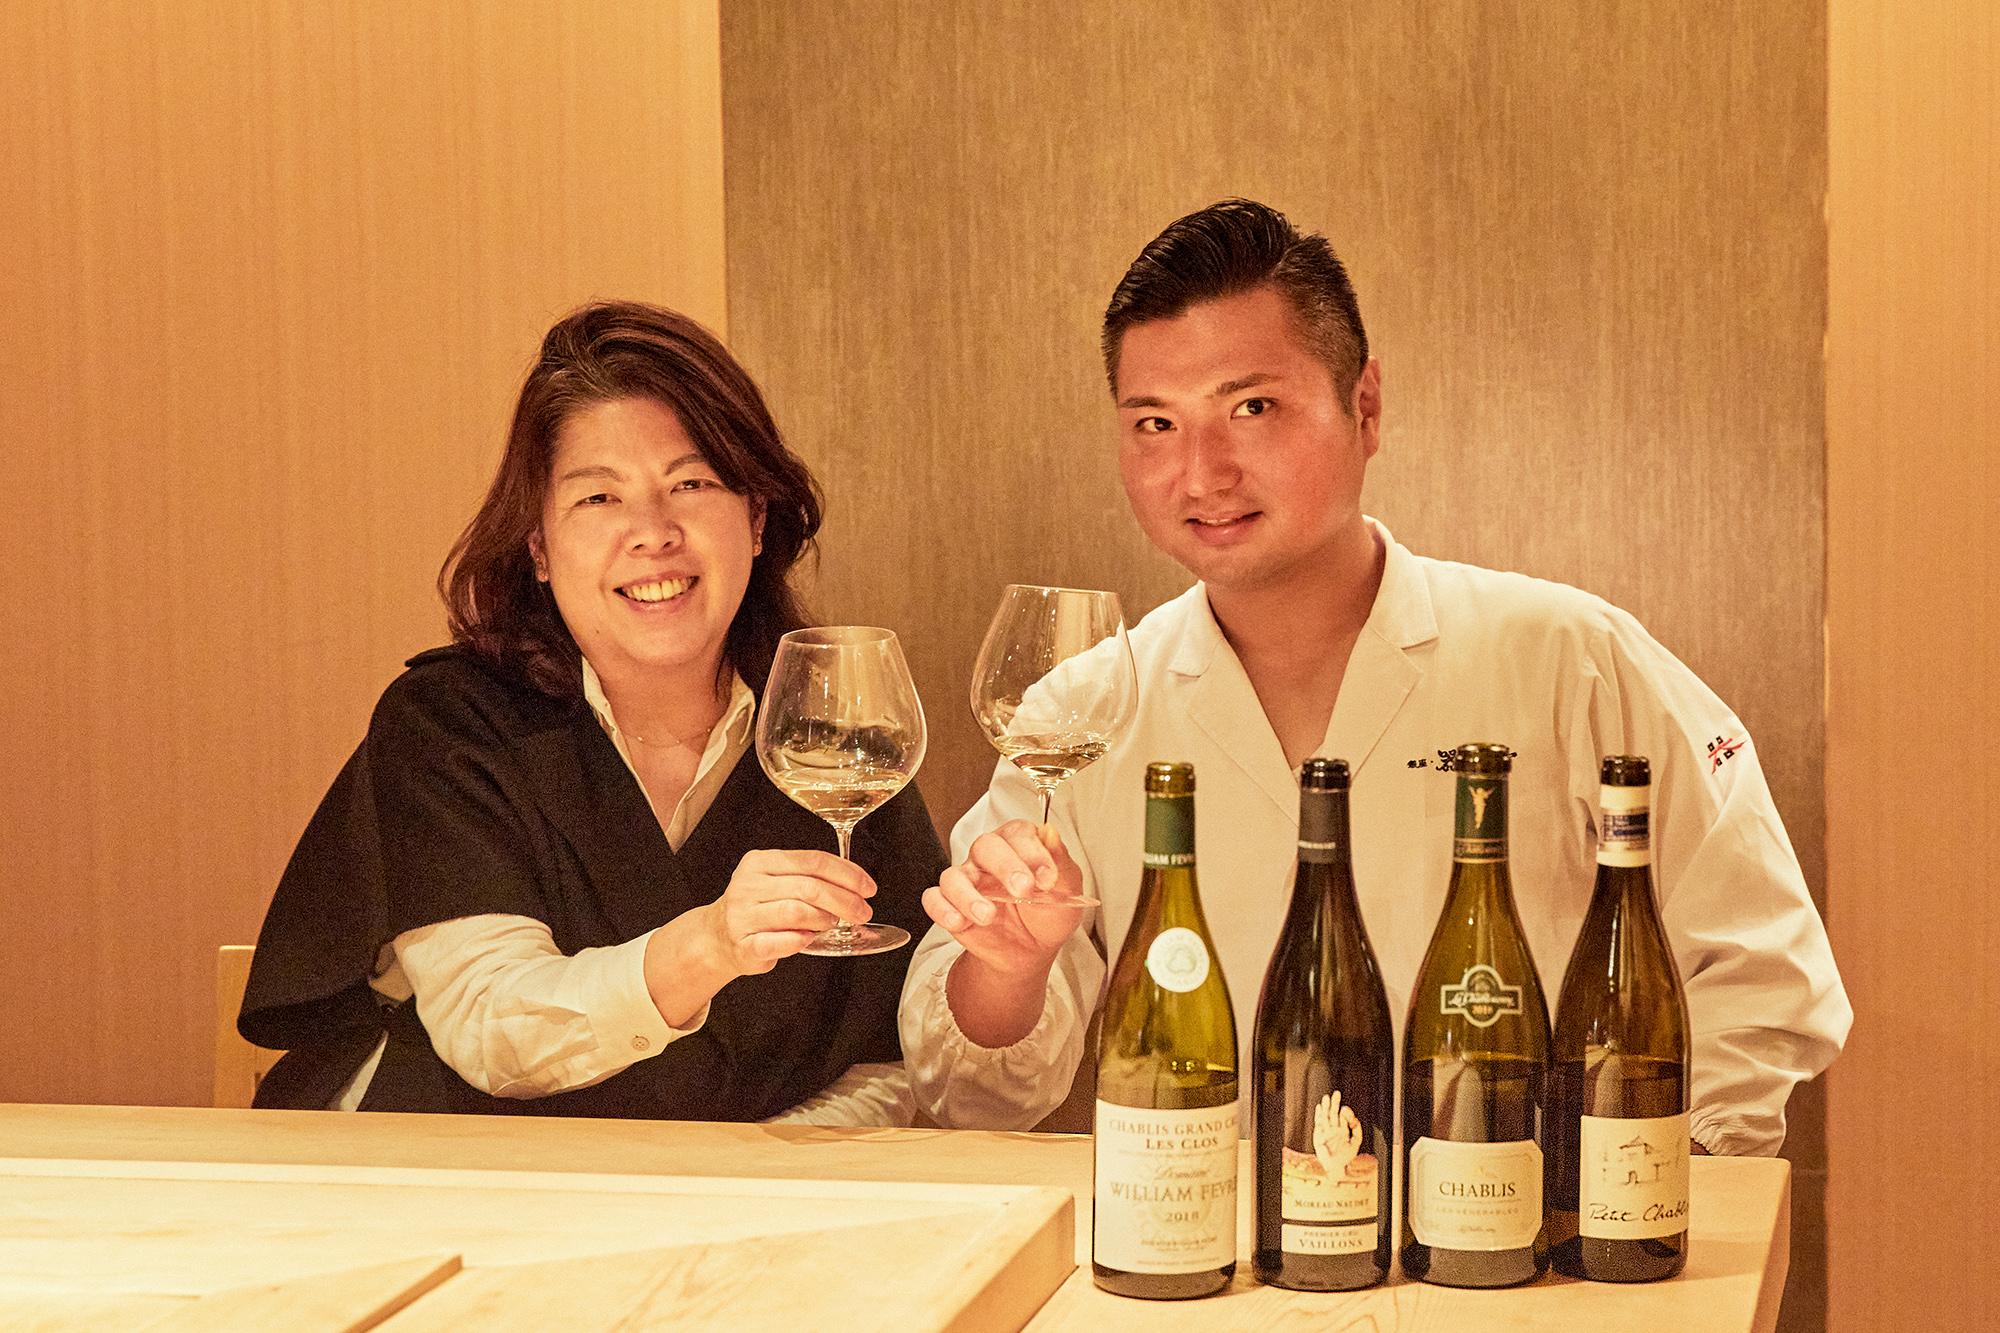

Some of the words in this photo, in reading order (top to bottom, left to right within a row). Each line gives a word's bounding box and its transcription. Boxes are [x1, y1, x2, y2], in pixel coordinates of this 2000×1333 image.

[1109, 1118, 1169, 1136] CHABLIS
[1174, 1120, 1223, 1136] GRAND
[1146, 1138, 1175, 1150] LES
[1181, 1136, 1219, 1150] CLOS
[1109, 1180, 1193, 1202] WILLIAM
[1438, 1181, 1516, 1198] CHABLIS
[1294, 1199, 1332, 1209] MOREAU
[1336, 1197, 1369, 1208] NAUDET
[1589, 1202, 1639, 1222] Petit
[1303, 1230, 1340, 1238] PREMIER
[1342, 1229, 1359, 1237] CRU
[1299, 1238, 1364, 1250] VAILLONS
